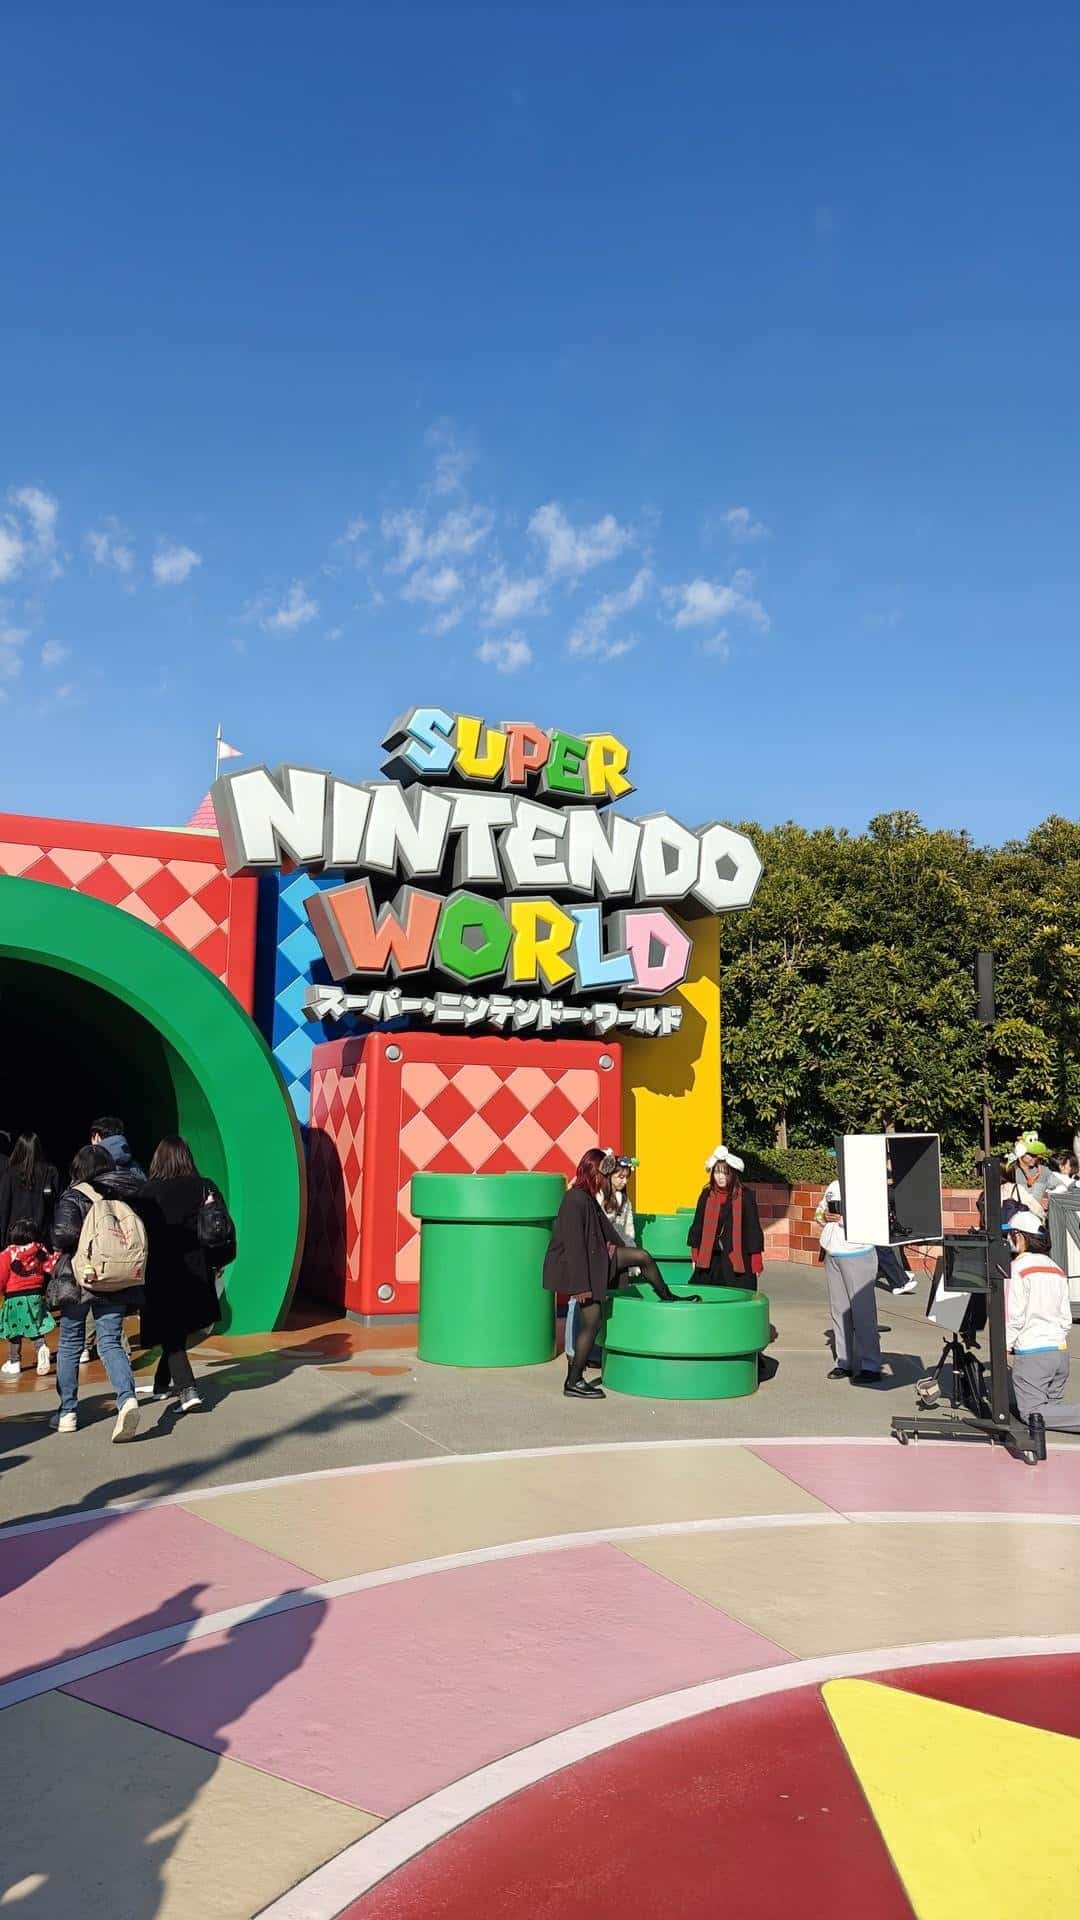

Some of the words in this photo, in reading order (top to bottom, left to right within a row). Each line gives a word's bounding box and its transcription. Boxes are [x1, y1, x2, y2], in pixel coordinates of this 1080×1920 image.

[395, 706, 635, 798] SUPER
[222, 766, 764, 911] NINTENDO
[322, 880, 692, 993] WORLD
